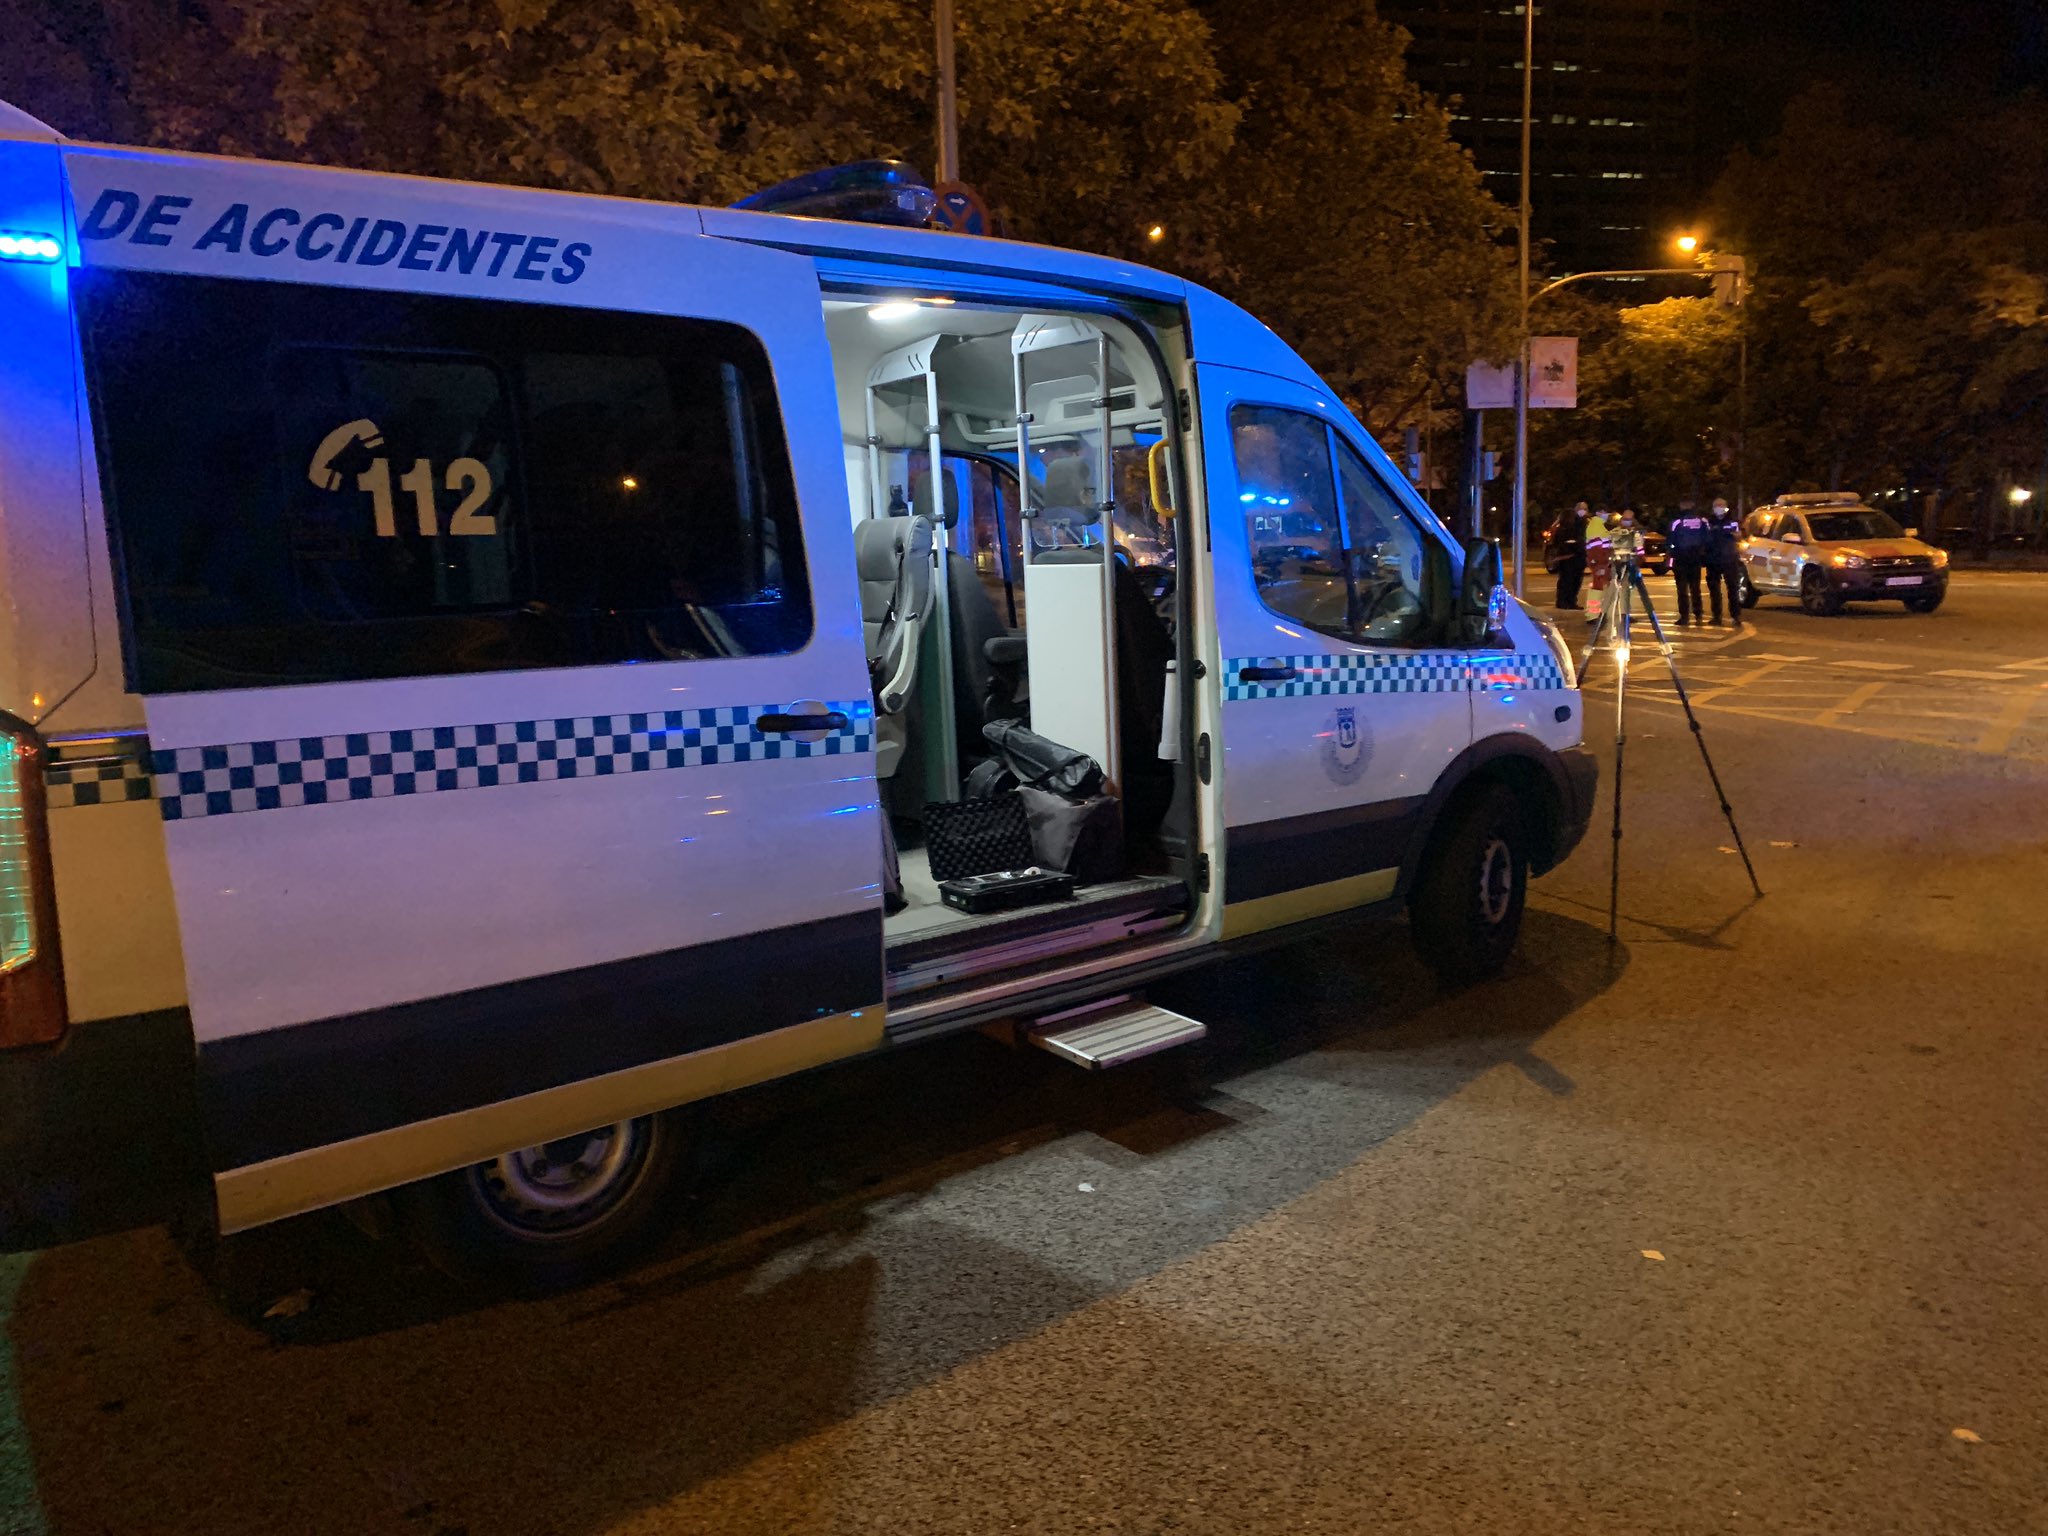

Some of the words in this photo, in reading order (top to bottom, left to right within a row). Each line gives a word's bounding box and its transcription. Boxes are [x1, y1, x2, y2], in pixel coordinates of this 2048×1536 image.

[80, 189, 193, 246] DE
[192, 203, 593, 284] ACCIDENTES
[357, 457, 497, 536] 112
